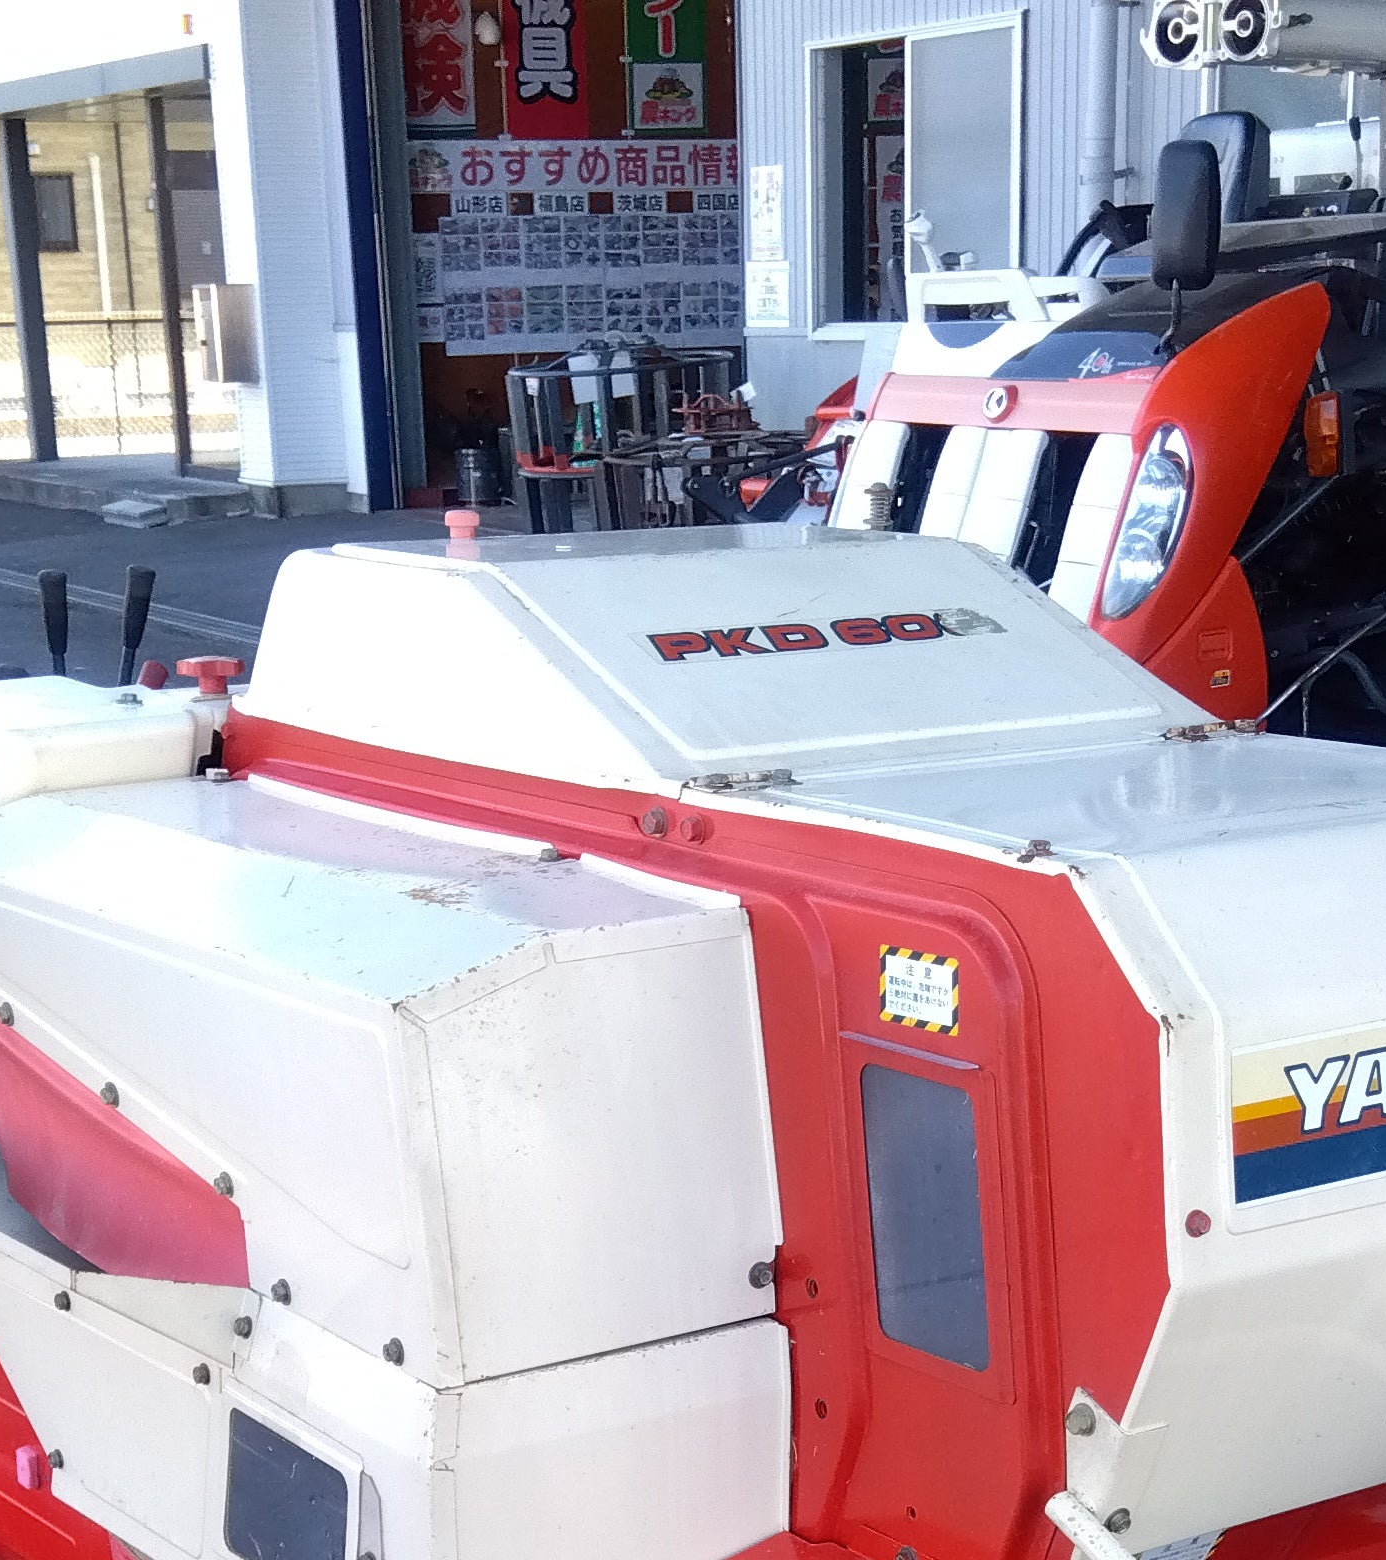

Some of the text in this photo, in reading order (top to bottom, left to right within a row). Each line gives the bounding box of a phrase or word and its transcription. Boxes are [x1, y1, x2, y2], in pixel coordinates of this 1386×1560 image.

[455, 195, 504, 214] 山形店
[538, 195, 585, 213] 福島店
[617, 194, 664, 212] 茨城店
[647, 612, 967, 661] PKD 60
